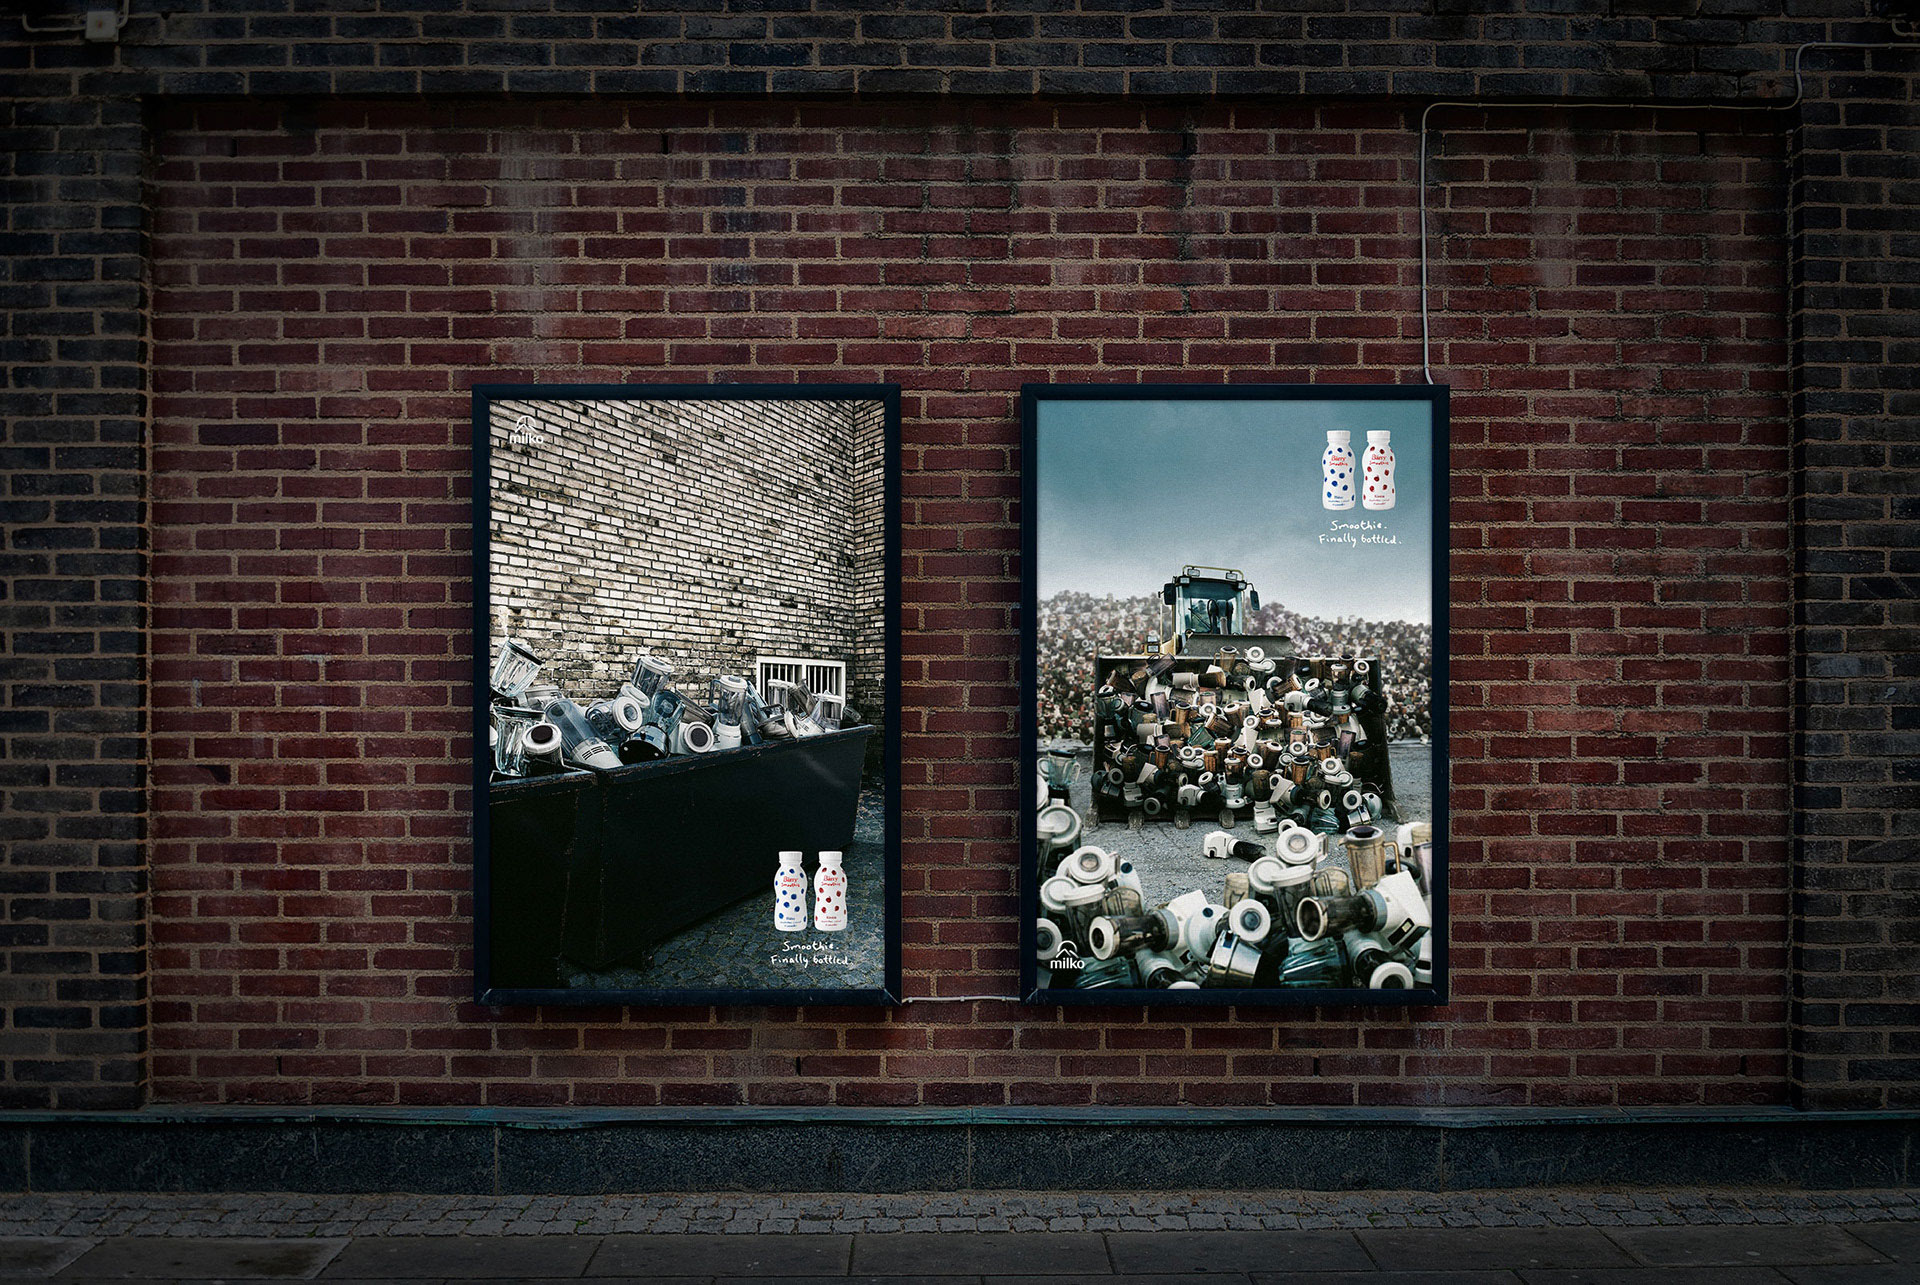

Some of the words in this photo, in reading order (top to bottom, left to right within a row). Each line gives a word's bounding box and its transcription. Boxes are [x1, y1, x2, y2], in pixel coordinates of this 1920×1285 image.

[510, 432, 544, 444] milko
[1330, 520, 1387, 531] Smoothie.
[1318, 532, 1357, 548] Finally
[1361, 534, 1402, 544] bottled.
[782, 940, 839, 952] Smoothie.
[770, 953, 809, 968] Finally
[813, 955, 854, 966] bottled.
[1050, 957, 1085, 969] milko
